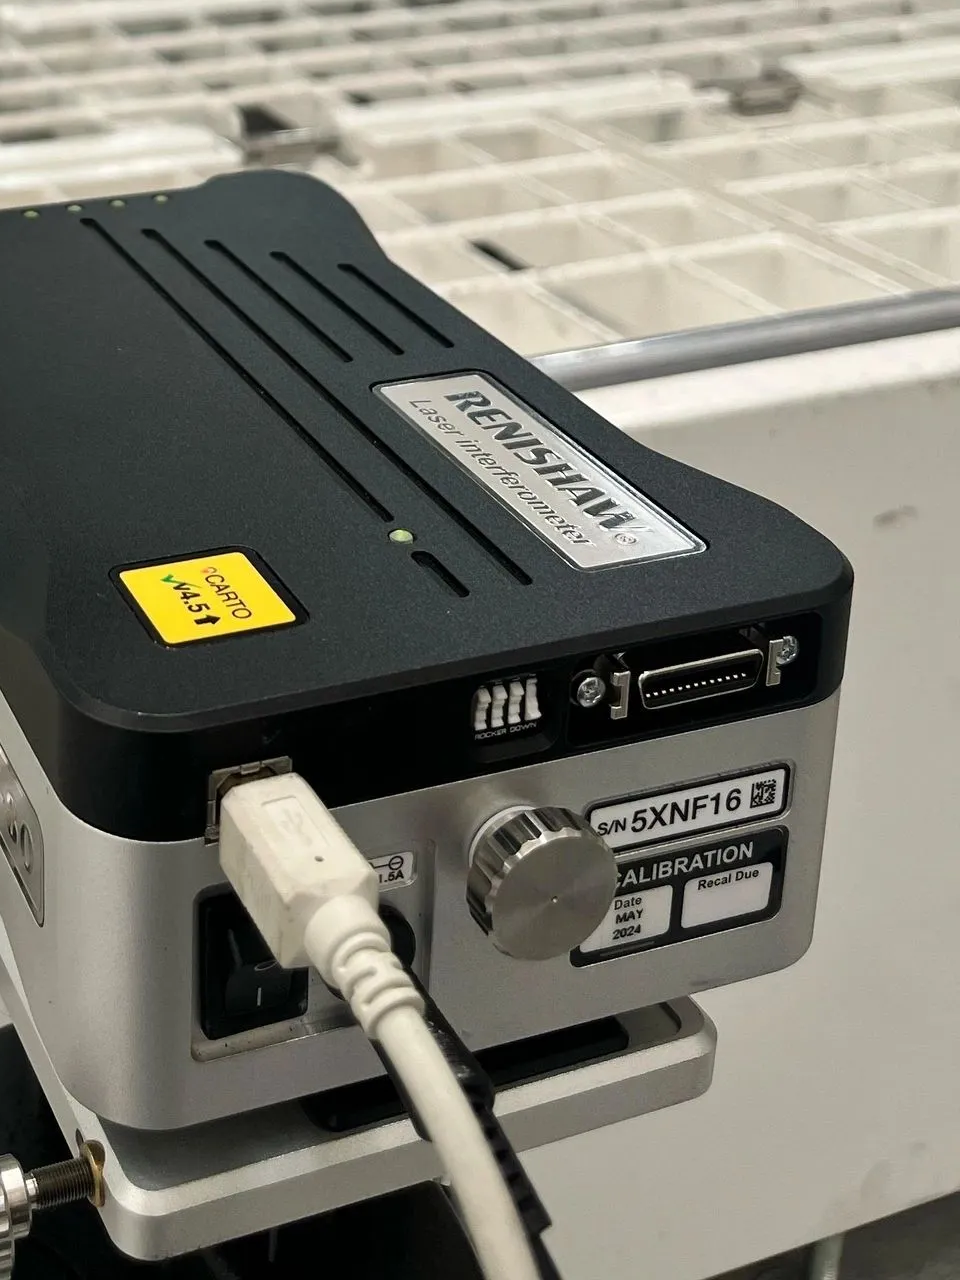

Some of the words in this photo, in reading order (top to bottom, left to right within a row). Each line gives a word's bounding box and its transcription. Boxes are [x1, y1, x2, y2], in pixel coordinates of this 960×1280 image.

[444, 390, 654, 534] RENISHAW
[409, 399, 464, 437] Laser
[456, 437, 596, 548] interferometer
[205, 574, 252, 619] CARTO
[509, 722, 537, 733] DOWN
[597, 817, 627, 836] S/N
[631, 788, 742, 833] 5XNF16
[697, 876, 732, 891] Recal
[735, 869, 760, 883] Due
[614, 896, 643, 911] Date
[615, 908, 644, 924] MAY
[612, 924, 642, 941] 2024
